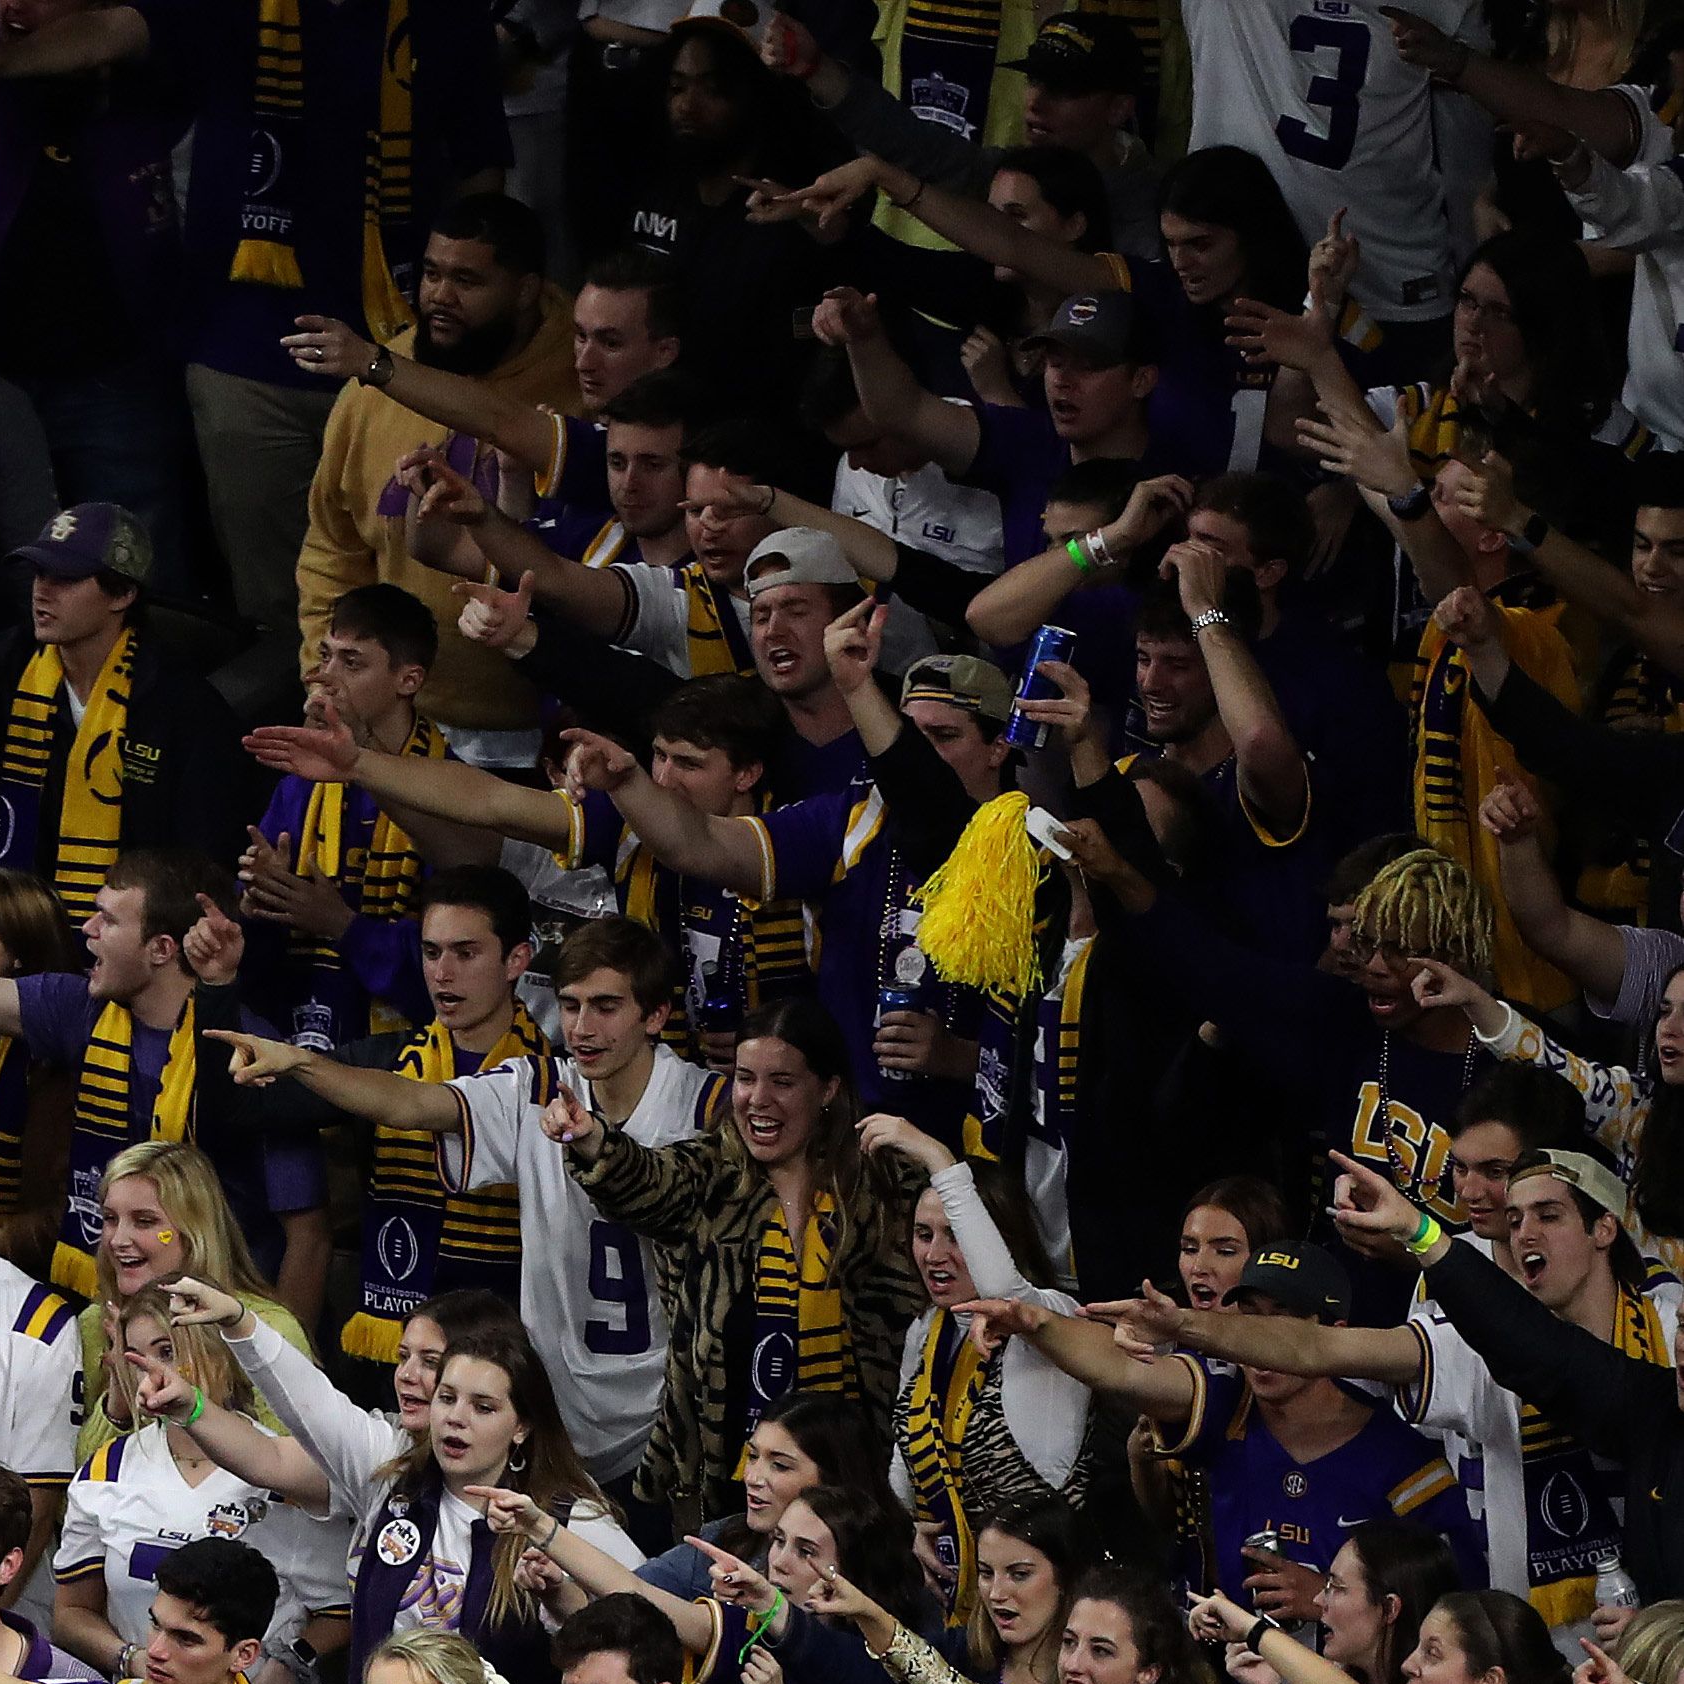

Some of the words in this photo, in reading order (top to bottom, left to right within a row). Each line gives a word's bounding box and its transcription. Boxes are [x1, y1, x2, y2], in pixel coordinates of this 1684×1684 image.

[1276, 14, 1371, 171] 3
[242, 214, 291, 233] YOFF
[923, 523, 956, 543] LSU
[125, 740, 160, 763] LSU
[1257, 1253, 1299, 1269] LSU
[587, 1221, 651, 1354] 9
[157, 1528, 191, 1542] LSU
[391, 1520, 418, 1546] THETA
[1533, 1545, 1620, 1577] PLAYOFF
